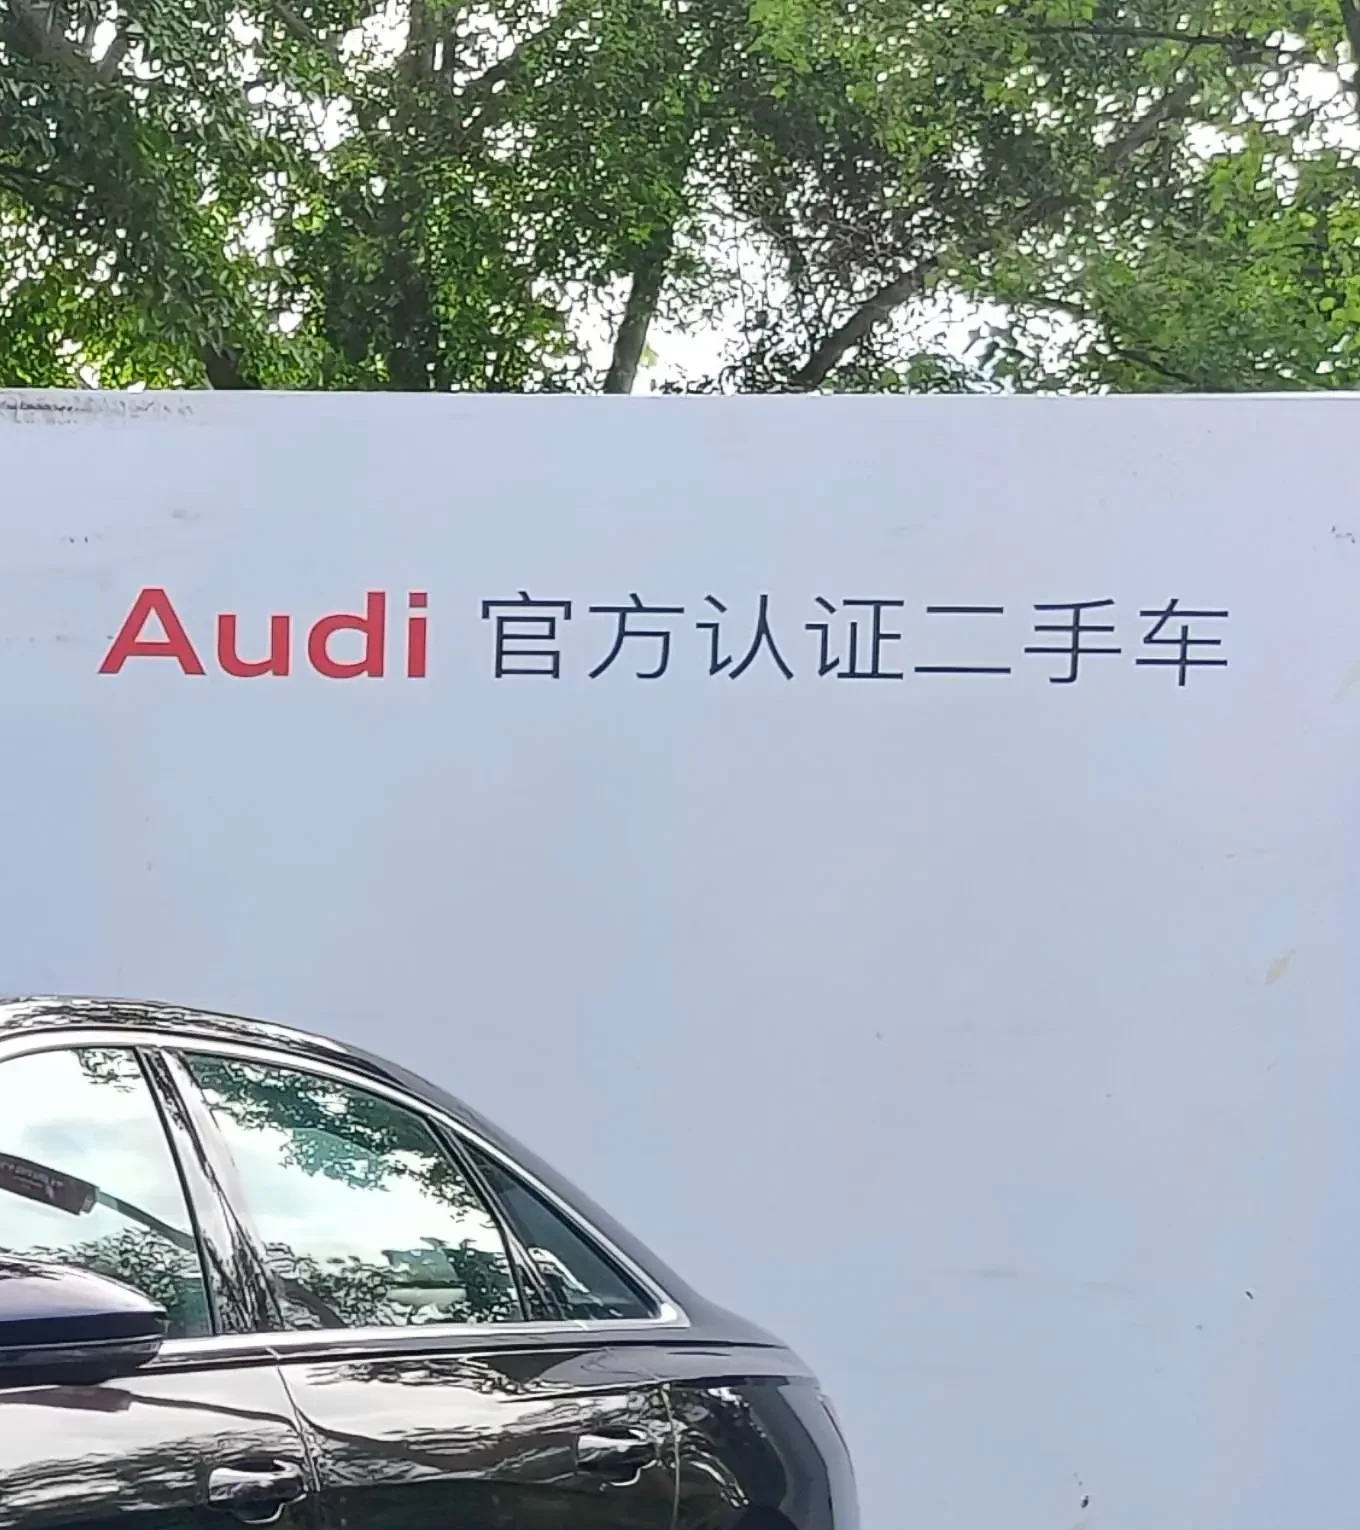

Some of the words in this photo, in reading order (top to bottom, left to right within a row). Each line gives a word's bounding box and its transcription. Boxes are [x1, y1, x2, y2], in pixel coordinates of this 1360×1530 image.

[98, 587, 429, 679] Audi
[480, 591, 1230, 688] 官方认证二手车
